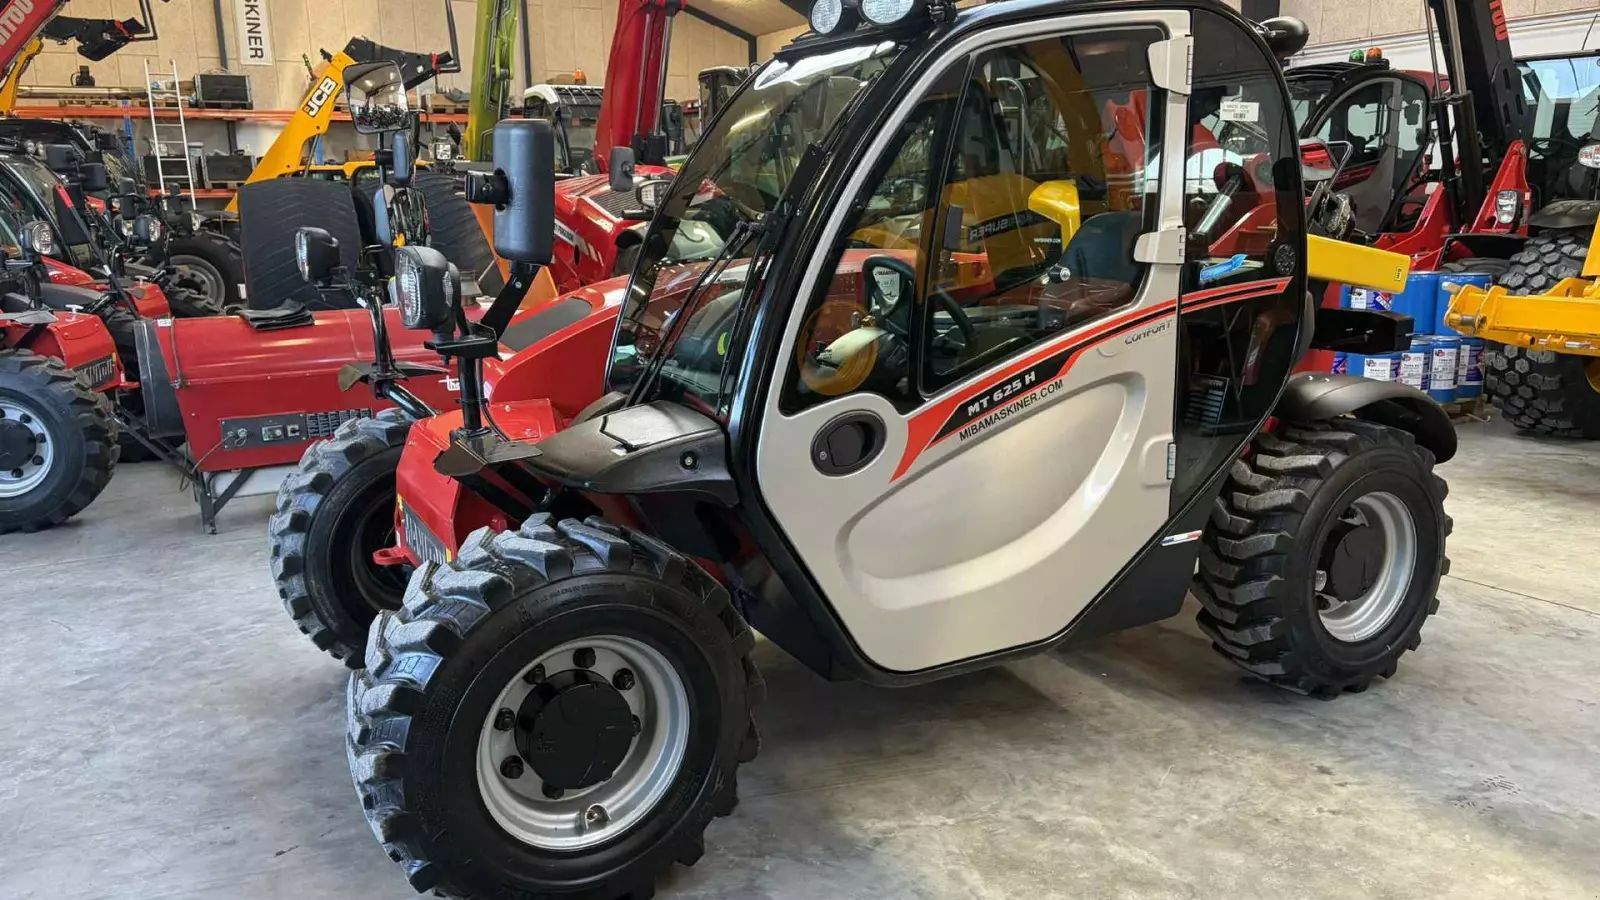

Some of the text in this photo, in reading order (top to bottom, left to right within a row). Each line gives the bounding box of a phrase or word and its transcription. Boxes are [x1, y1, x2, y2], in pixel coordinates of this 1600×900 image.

[244, 0, 264, 58] KINER
[303, 76, 338, 117] JCB
[959, 379, 1064, 441] MIBAMASKINER.COM
[967, 371, 1036, 416] MT 625 H
